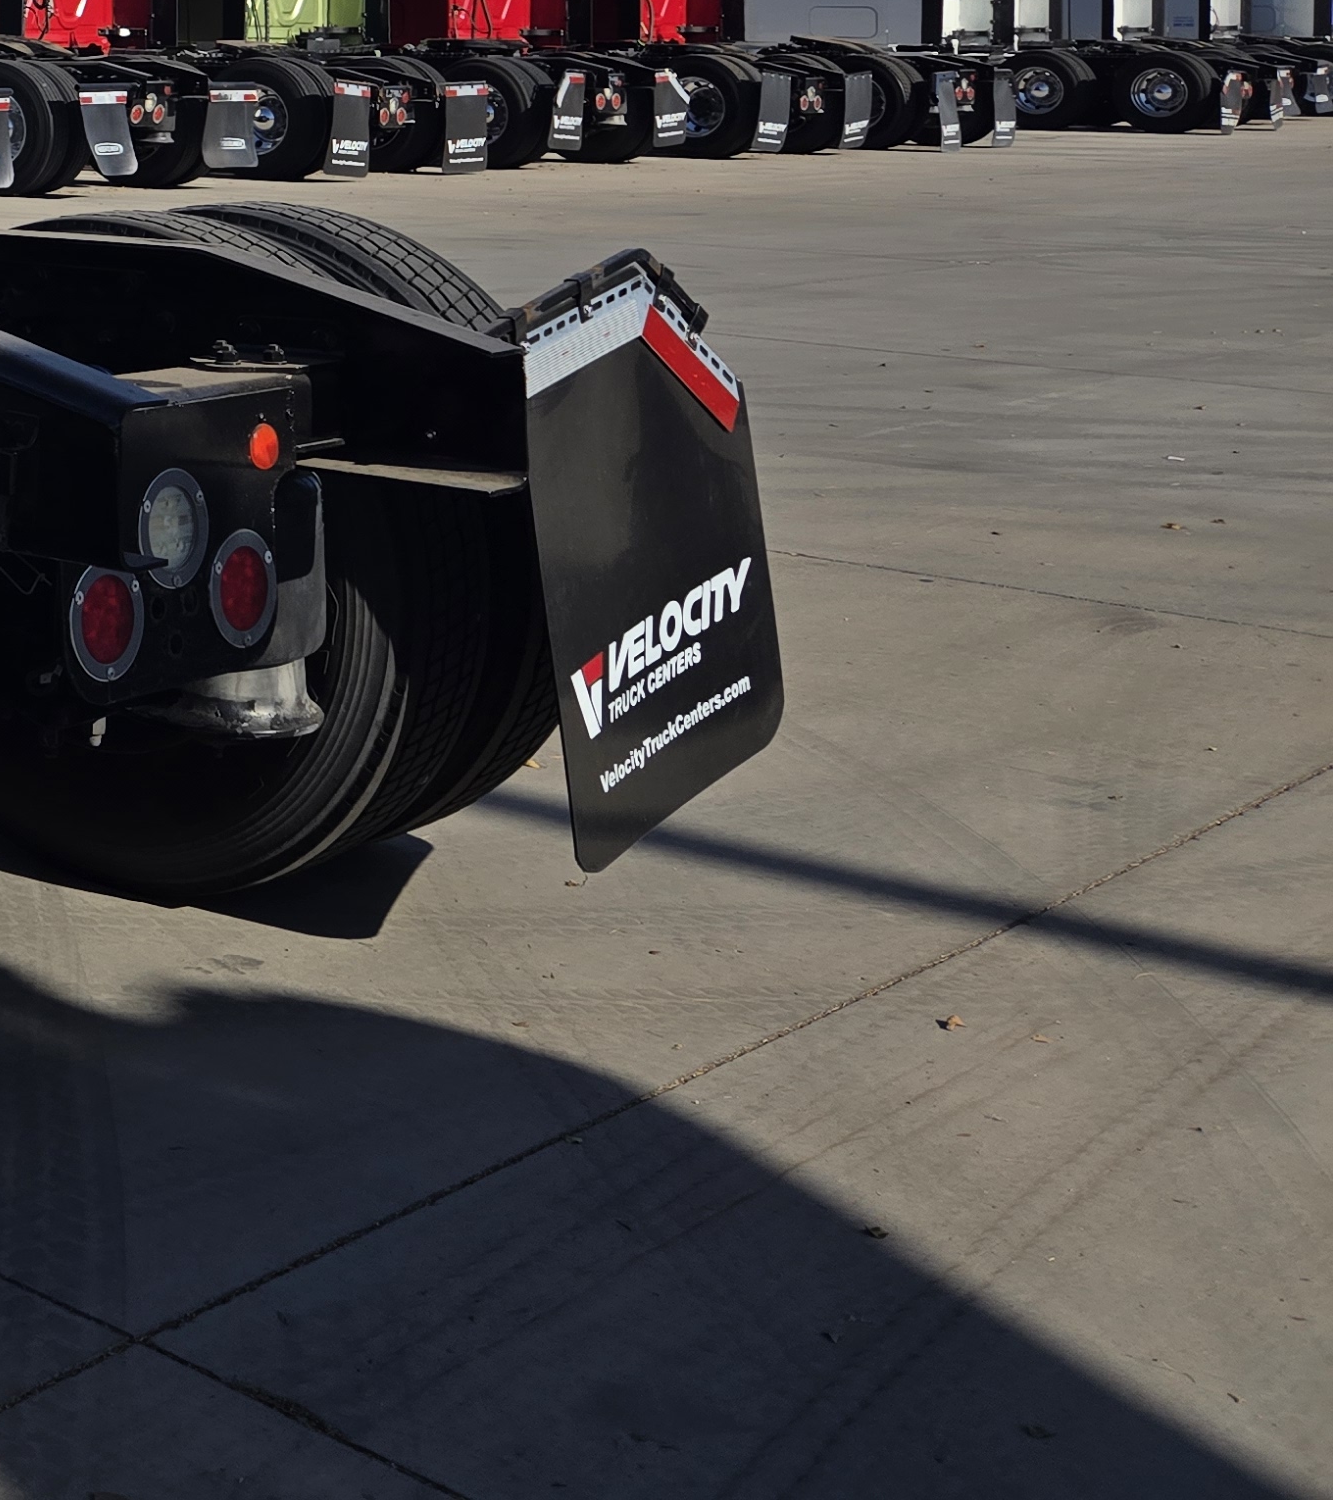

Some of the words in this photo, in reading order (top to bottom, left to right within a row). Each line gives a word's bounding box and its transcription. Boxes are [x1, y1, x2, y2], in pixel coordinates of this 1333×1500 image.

[607, 684, 646, 724] TRUCK
[645, 641, 702, 694] CENTERS
[608, 556, 752, 693] VELOCITY
[599, 674, 751, 794] VelocityTruckCenters.com
